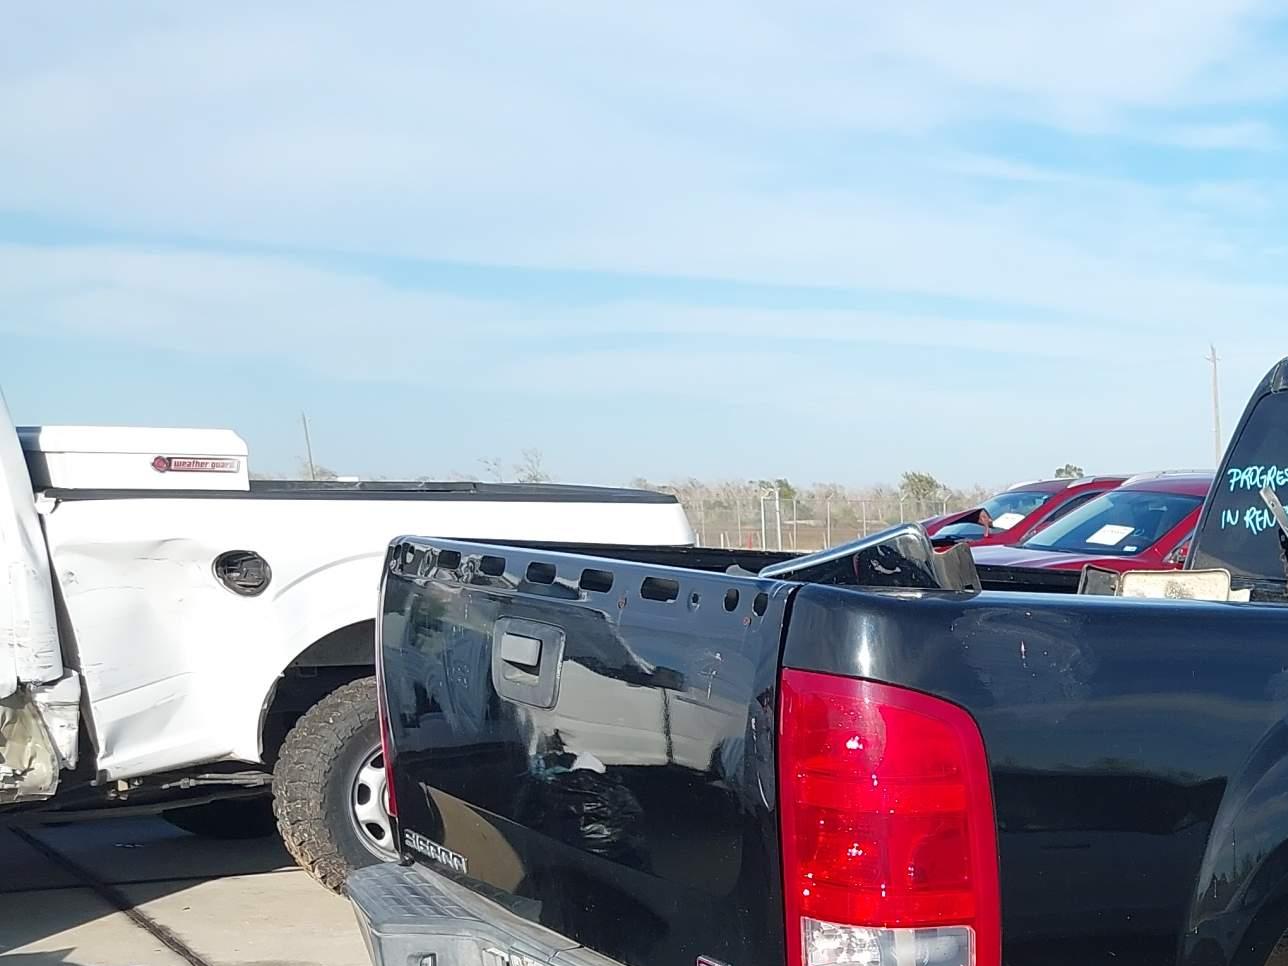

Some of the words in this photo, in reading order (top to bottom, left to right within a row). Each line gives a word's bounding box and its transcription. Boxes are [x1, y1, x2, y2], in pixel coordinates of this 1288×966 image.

[173, 460, 208, 469] weather
[1221, 509, 1240, 529] IN
[404, 828, 467, 874] SIERRA
